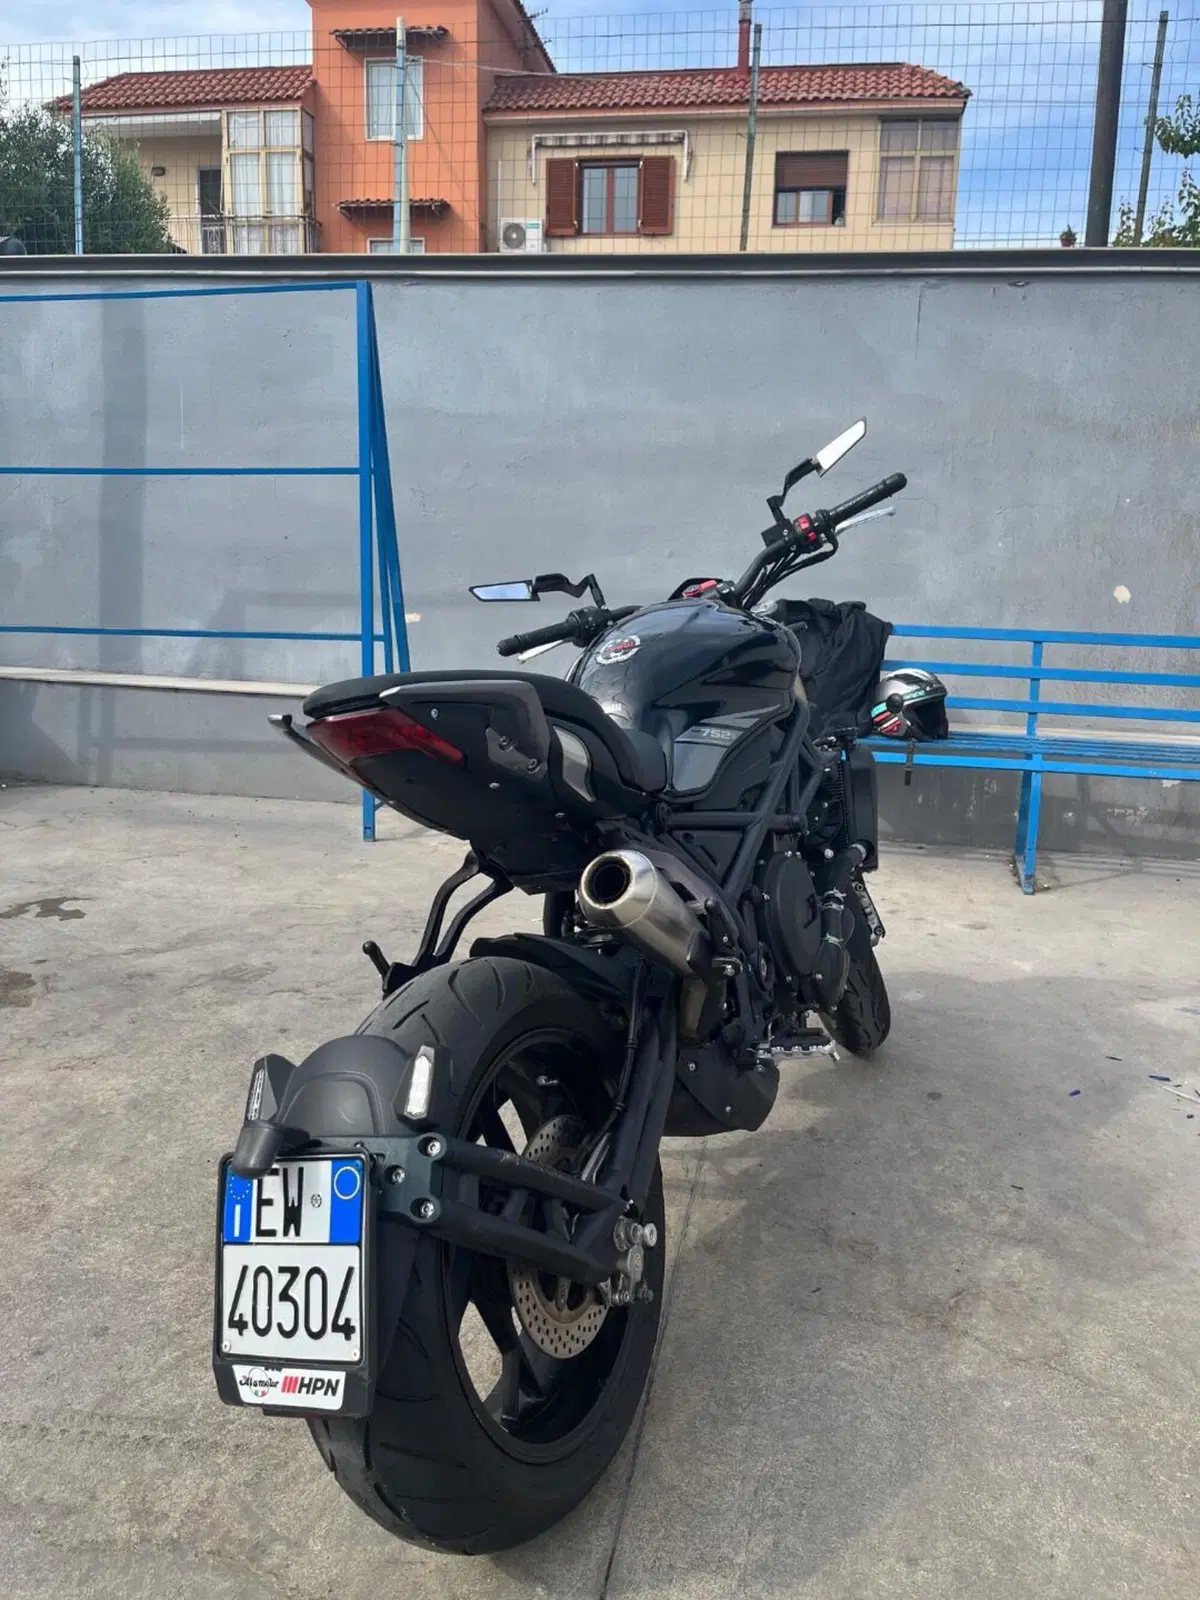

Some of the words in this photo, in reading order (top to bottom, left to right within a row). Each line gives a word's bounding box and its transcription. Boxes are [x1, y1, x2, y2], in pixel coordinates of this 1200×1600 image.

[256, 1167, 304, 1237] EW
[228, 1265, 356, 1341] 40304
[298, 1376, 340, 1396] HPN
